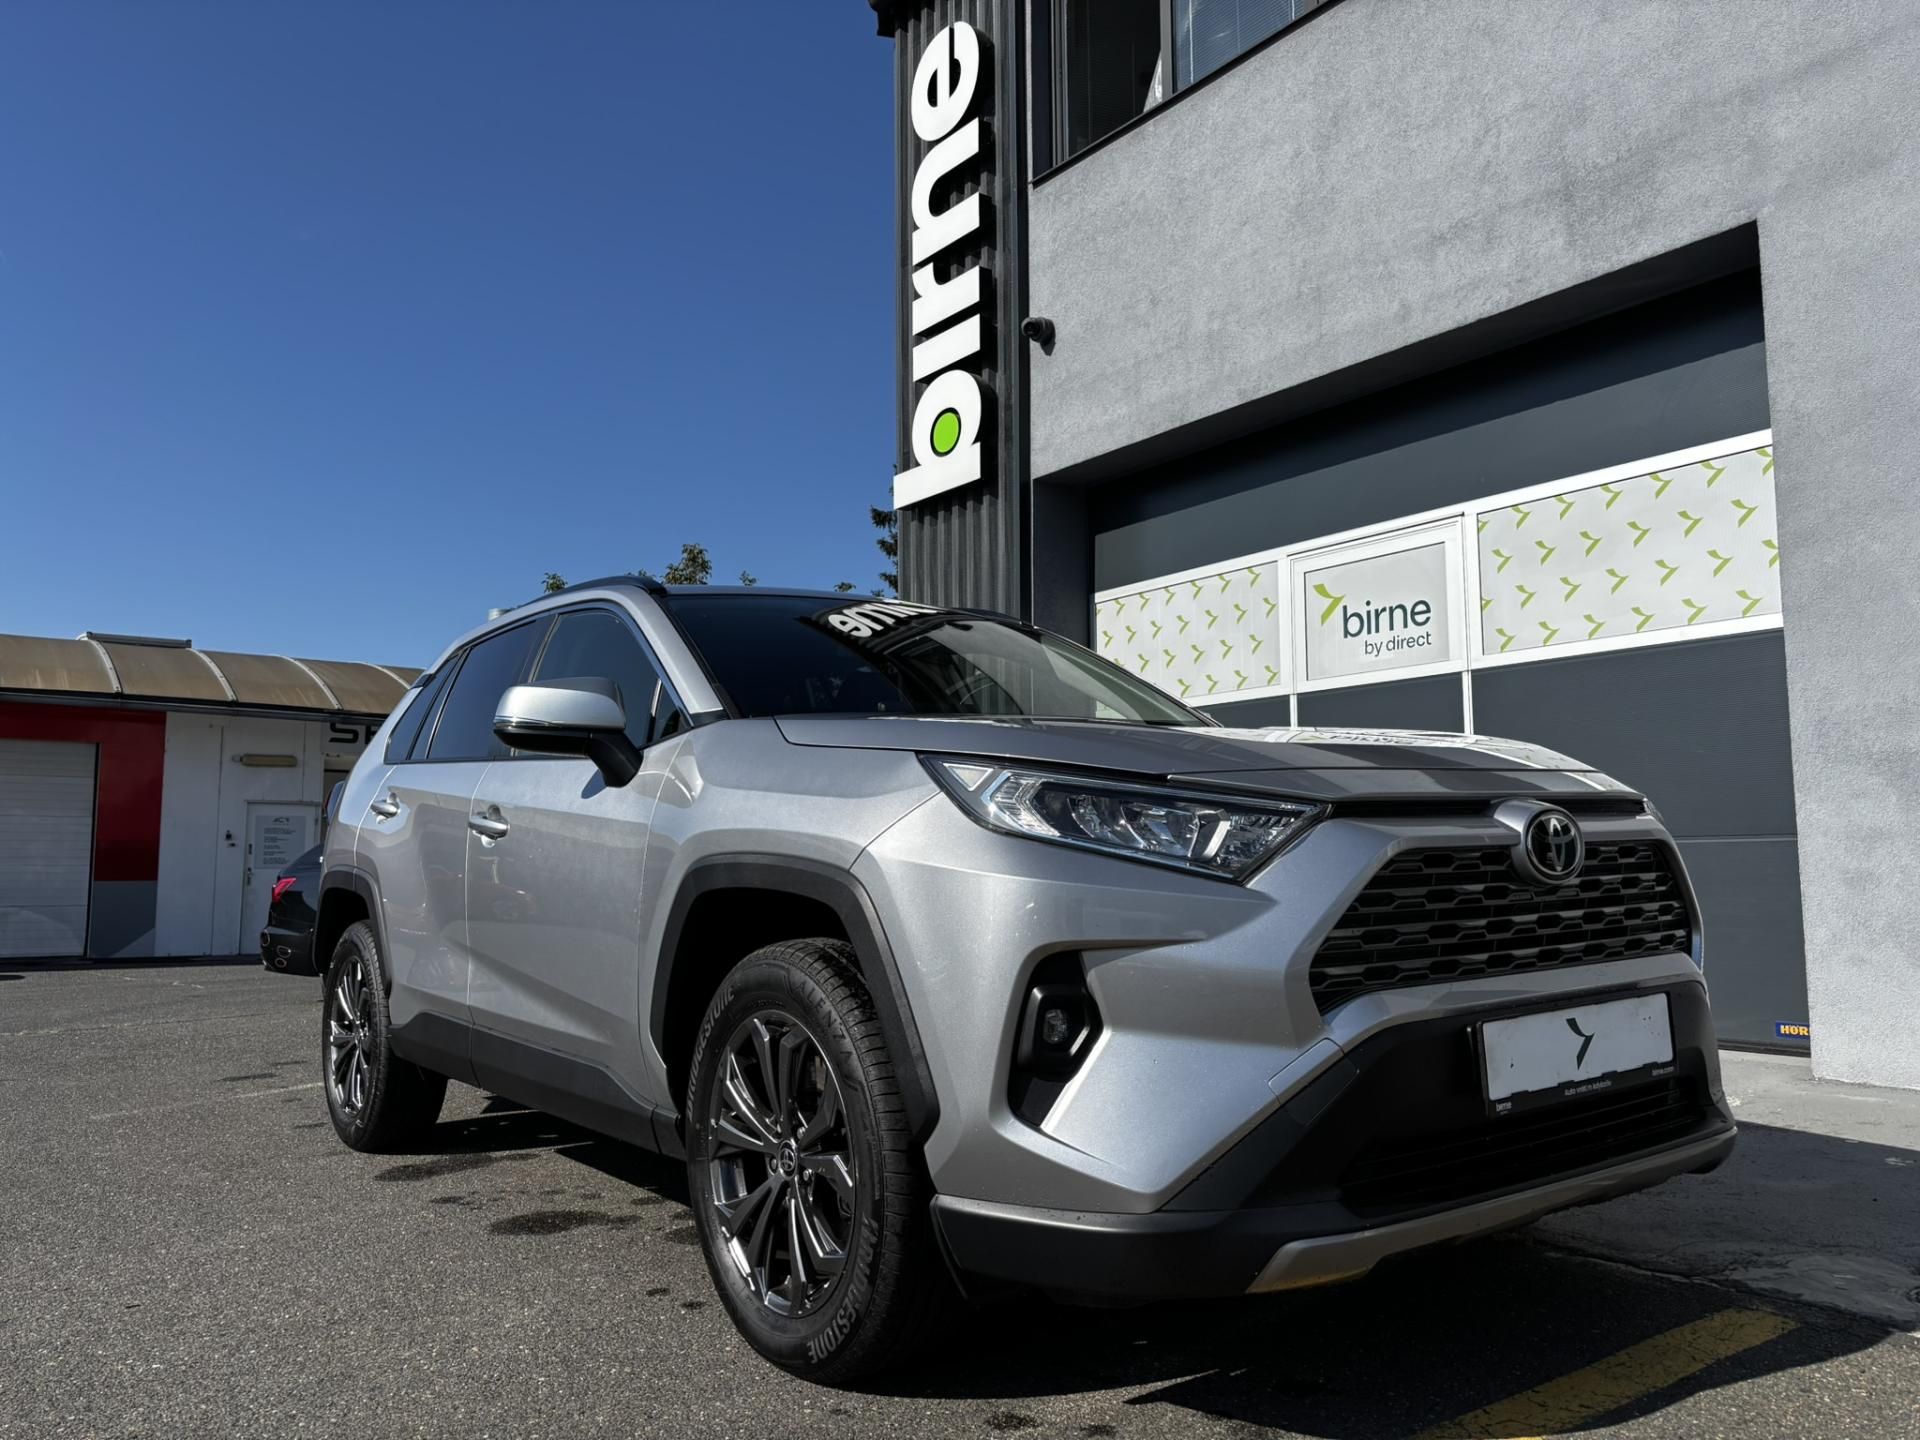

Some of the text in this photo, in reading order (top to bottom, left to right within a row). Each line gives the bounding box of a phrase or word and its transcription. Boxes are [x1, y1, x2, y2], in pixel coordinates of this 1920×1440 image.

[893, 20, 982, 510] birne
[1342, 600, 1432, 639] birne
[1364, 631, 1432, 657] by direct
